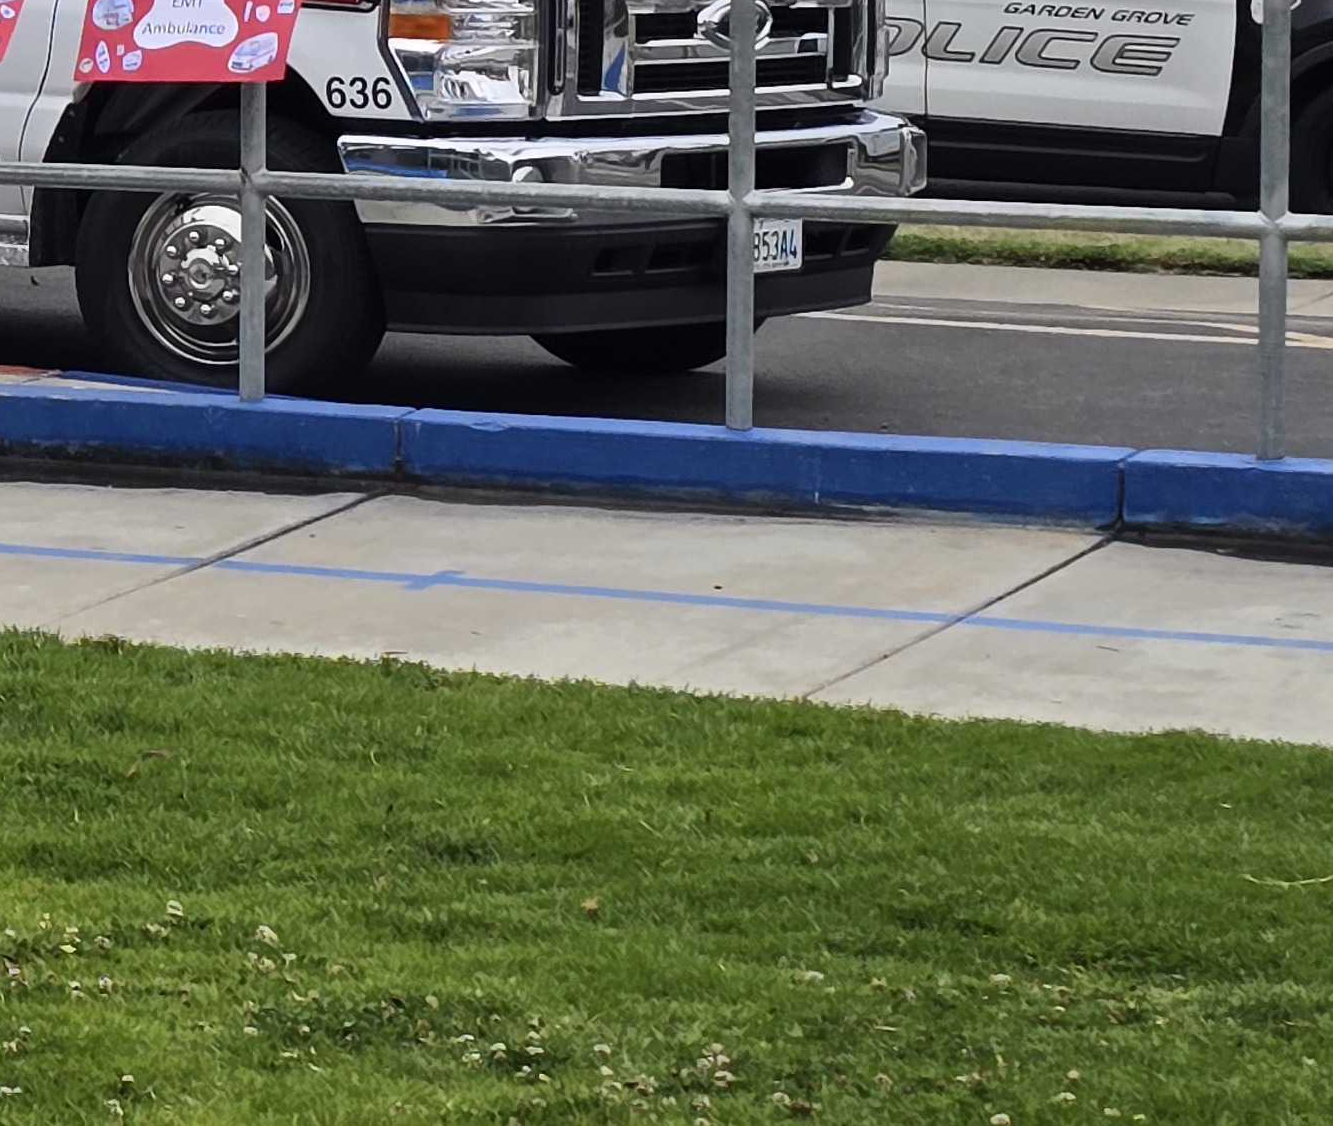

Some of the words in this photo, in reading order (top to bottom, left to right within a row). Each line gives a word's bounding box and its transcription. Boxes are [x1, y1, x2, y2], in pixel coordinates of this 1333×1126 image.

[1004, 2, 1106, 21] GARDEN
[1111, 9, 1196, 26] GROVE
[142, 21, 226, 35] Ambulance
[325, 76, 393, 109] 636
